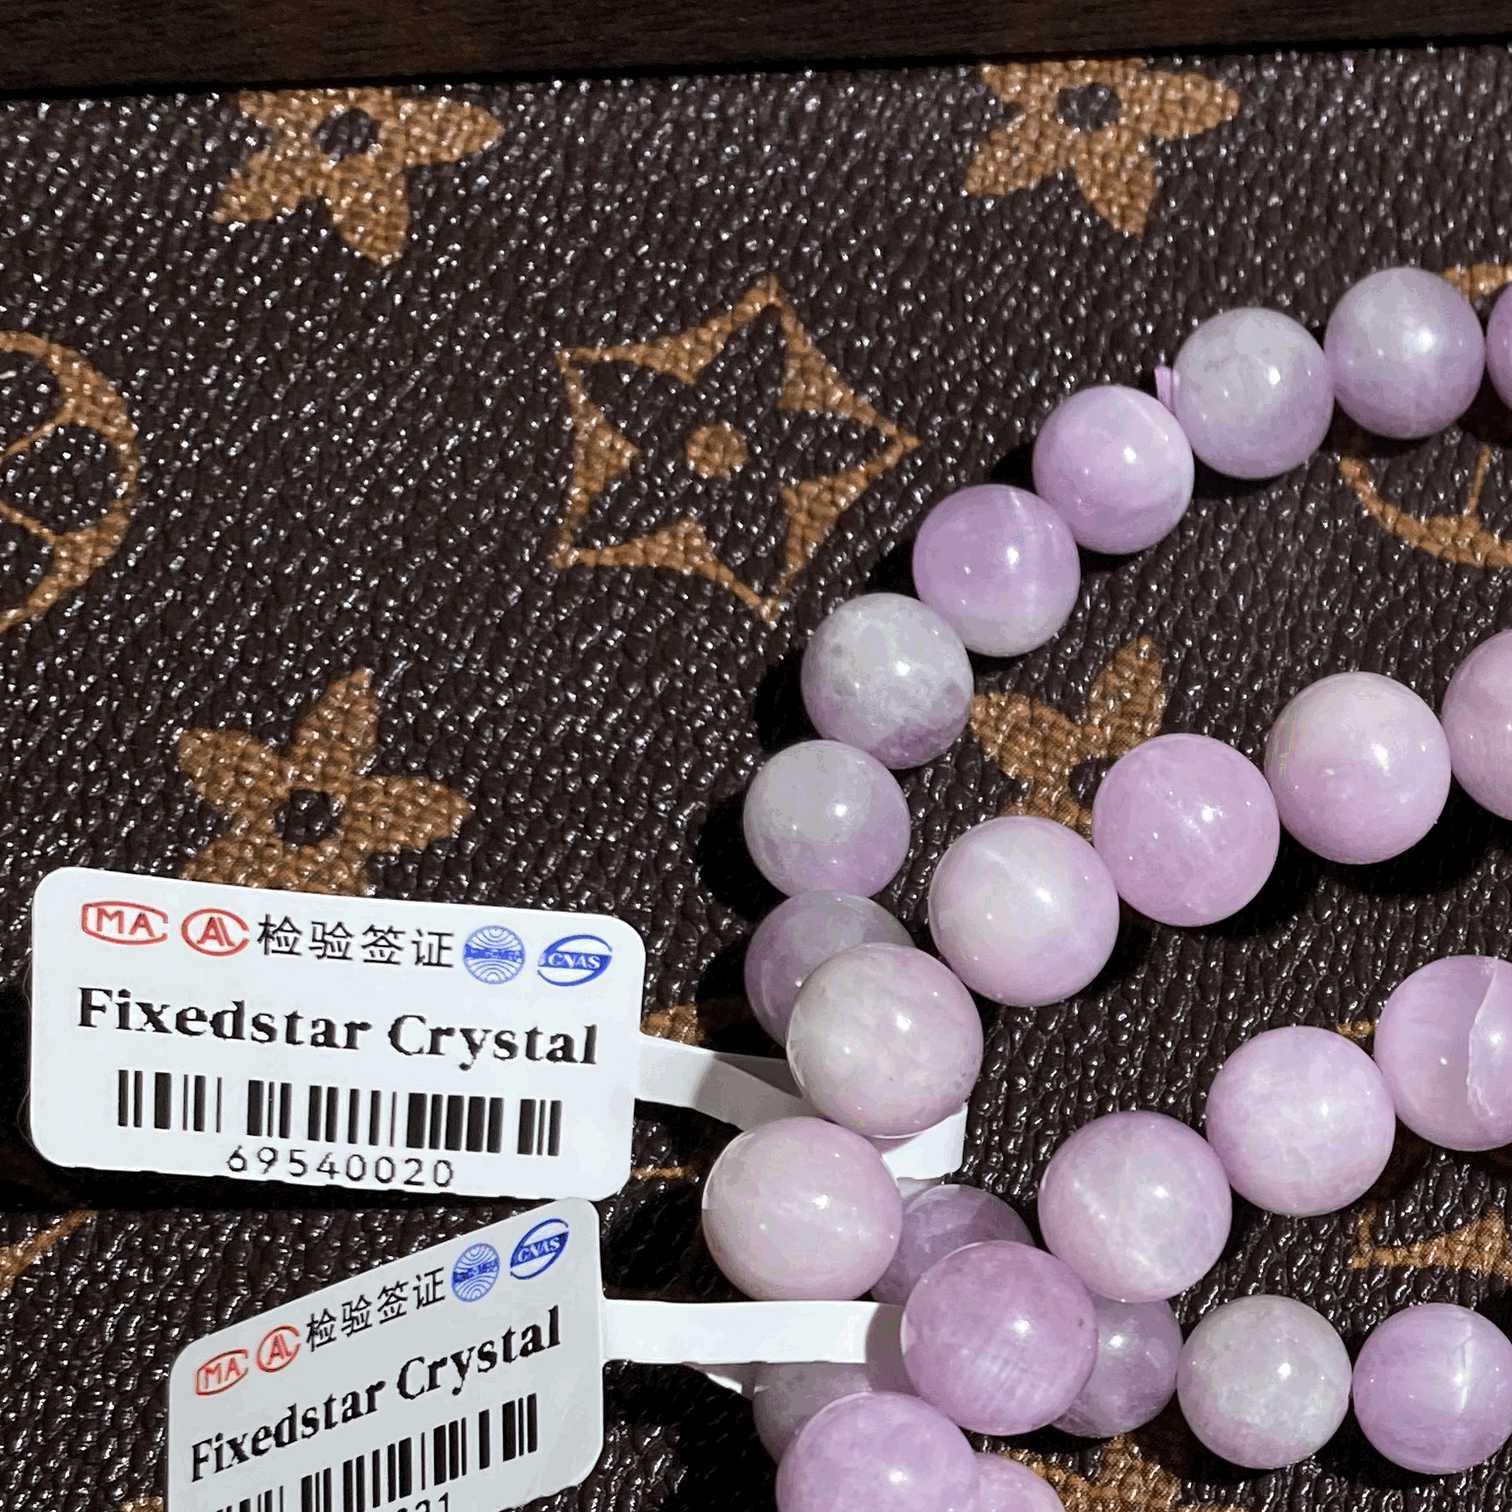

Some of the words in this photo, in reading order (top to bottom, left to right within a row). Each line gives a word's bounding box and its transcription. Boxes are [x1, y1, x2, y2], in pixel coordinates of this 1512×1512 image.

[257, 913, 455, 969] 检验签证
[547, 951, 601, 970] CNAS
[77, 986, 371, 1051] Fixedstar
[388, 1014, 598, 1070] Crystal
[226, 1144, 454, 1188] 69540020
[305, 1267, 446, 1353] 检验签证
[191, 1380, 387, 1483] Fixedstar
[396, 1304, 562, 1396] Crystal
